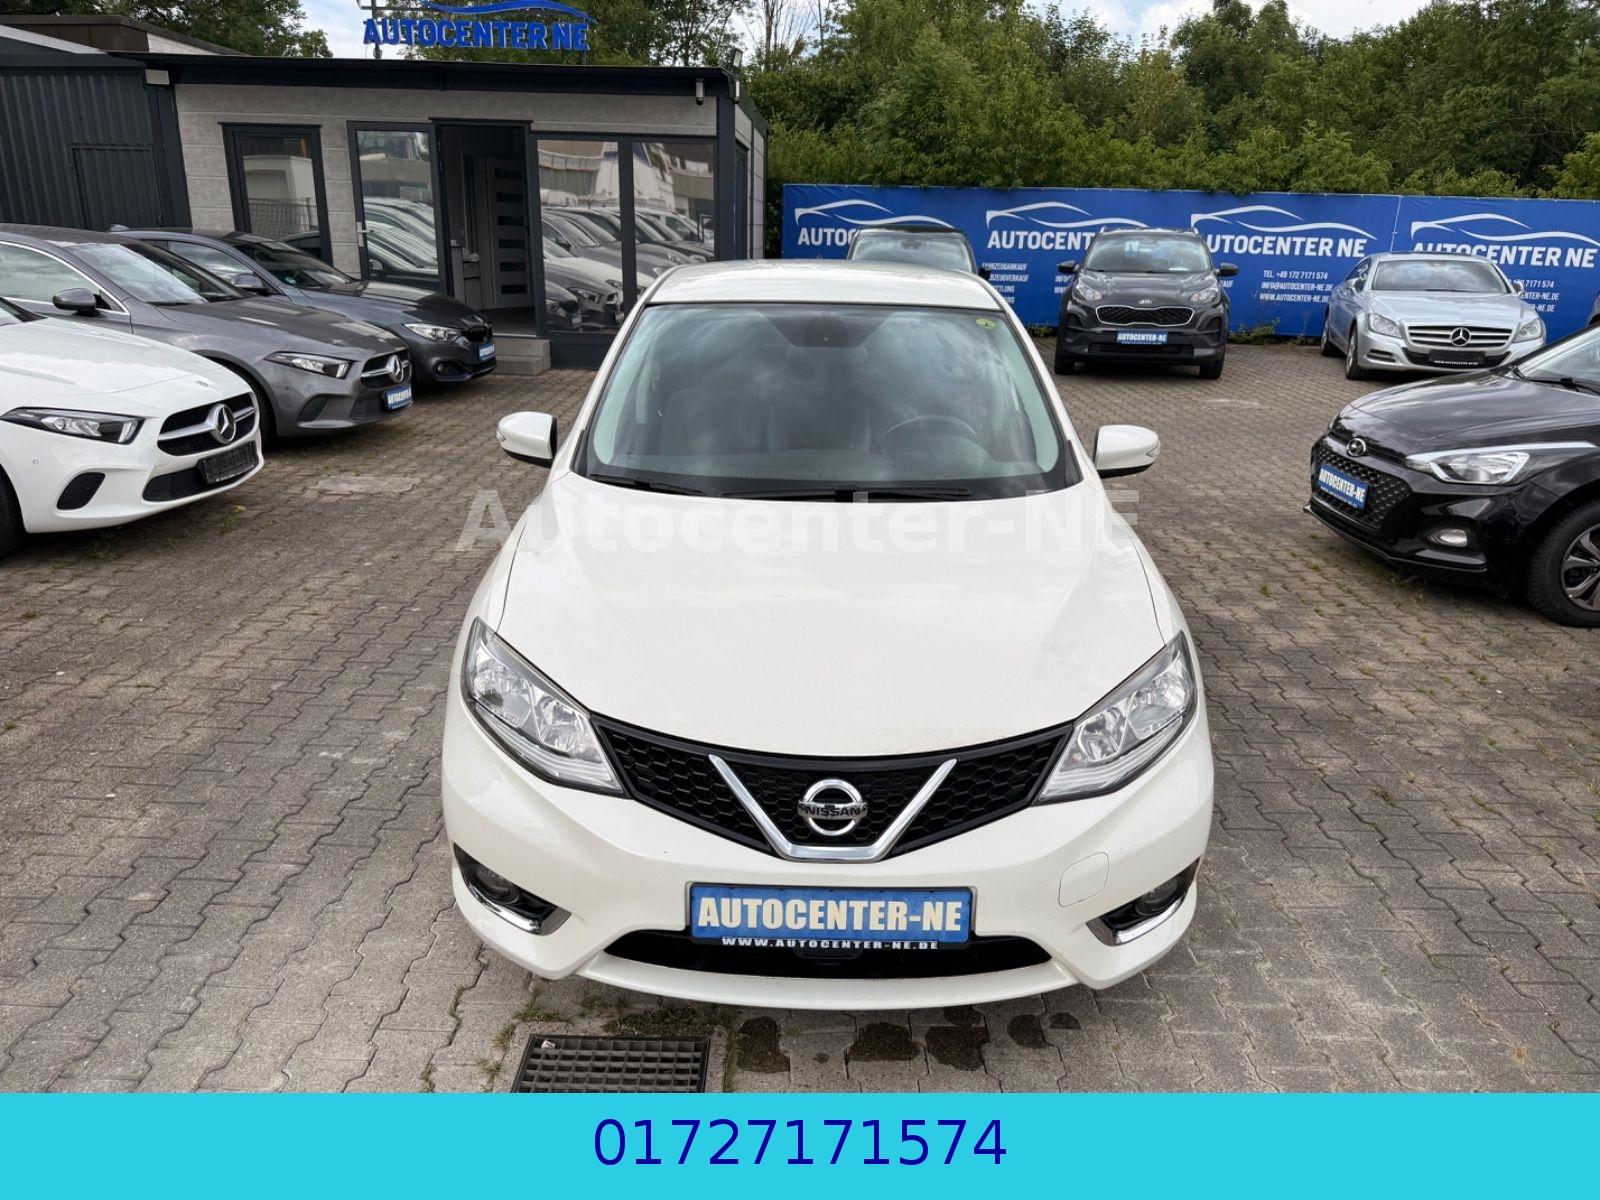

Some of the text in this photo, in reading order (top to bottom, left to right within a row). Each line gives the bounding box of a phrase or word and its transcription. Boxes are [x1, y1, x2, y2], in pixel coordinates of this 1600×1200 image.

[363, 18, 590, 51] AUTOCENTER NE
[1336, 237, 1368, 258] NE
[1565, 247, 1599, 268] NE
[1289, 270, 1300, 279] 172
[1300, 271, 1315, 280] 7171
[805, 805, 861, 818] NISSAN
[698, 897, 962, 931] AUTOCENTER-NE
[722, 936, 938, 950] WWW.AUTOCENTER-NE.DE
